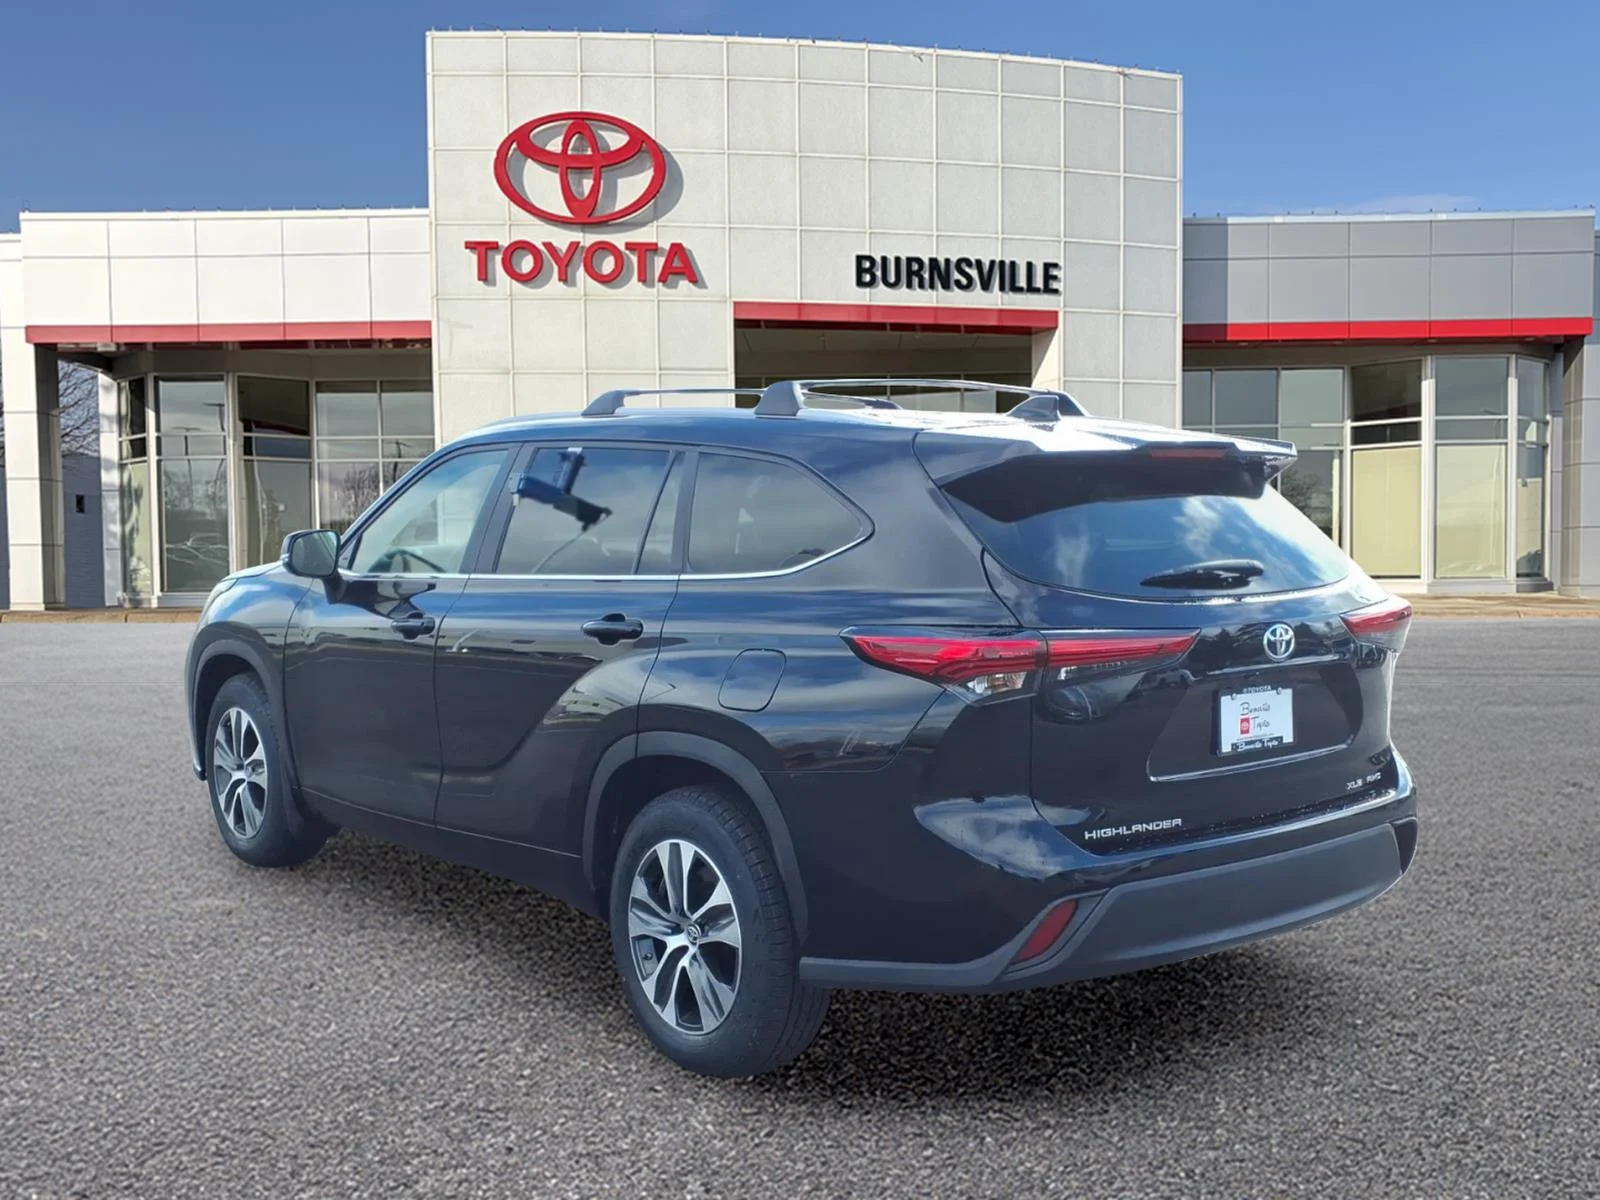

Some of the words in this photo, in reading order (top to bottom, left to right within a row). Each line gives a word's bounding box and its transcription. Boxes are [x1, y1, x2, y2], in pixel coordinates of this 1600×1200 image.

[464, 239, 699, 284] TOYOTA
[855, 254, 1062, 295] BURNSVILLE
[1084, 818, 1183, 841] HIGHLANDER
